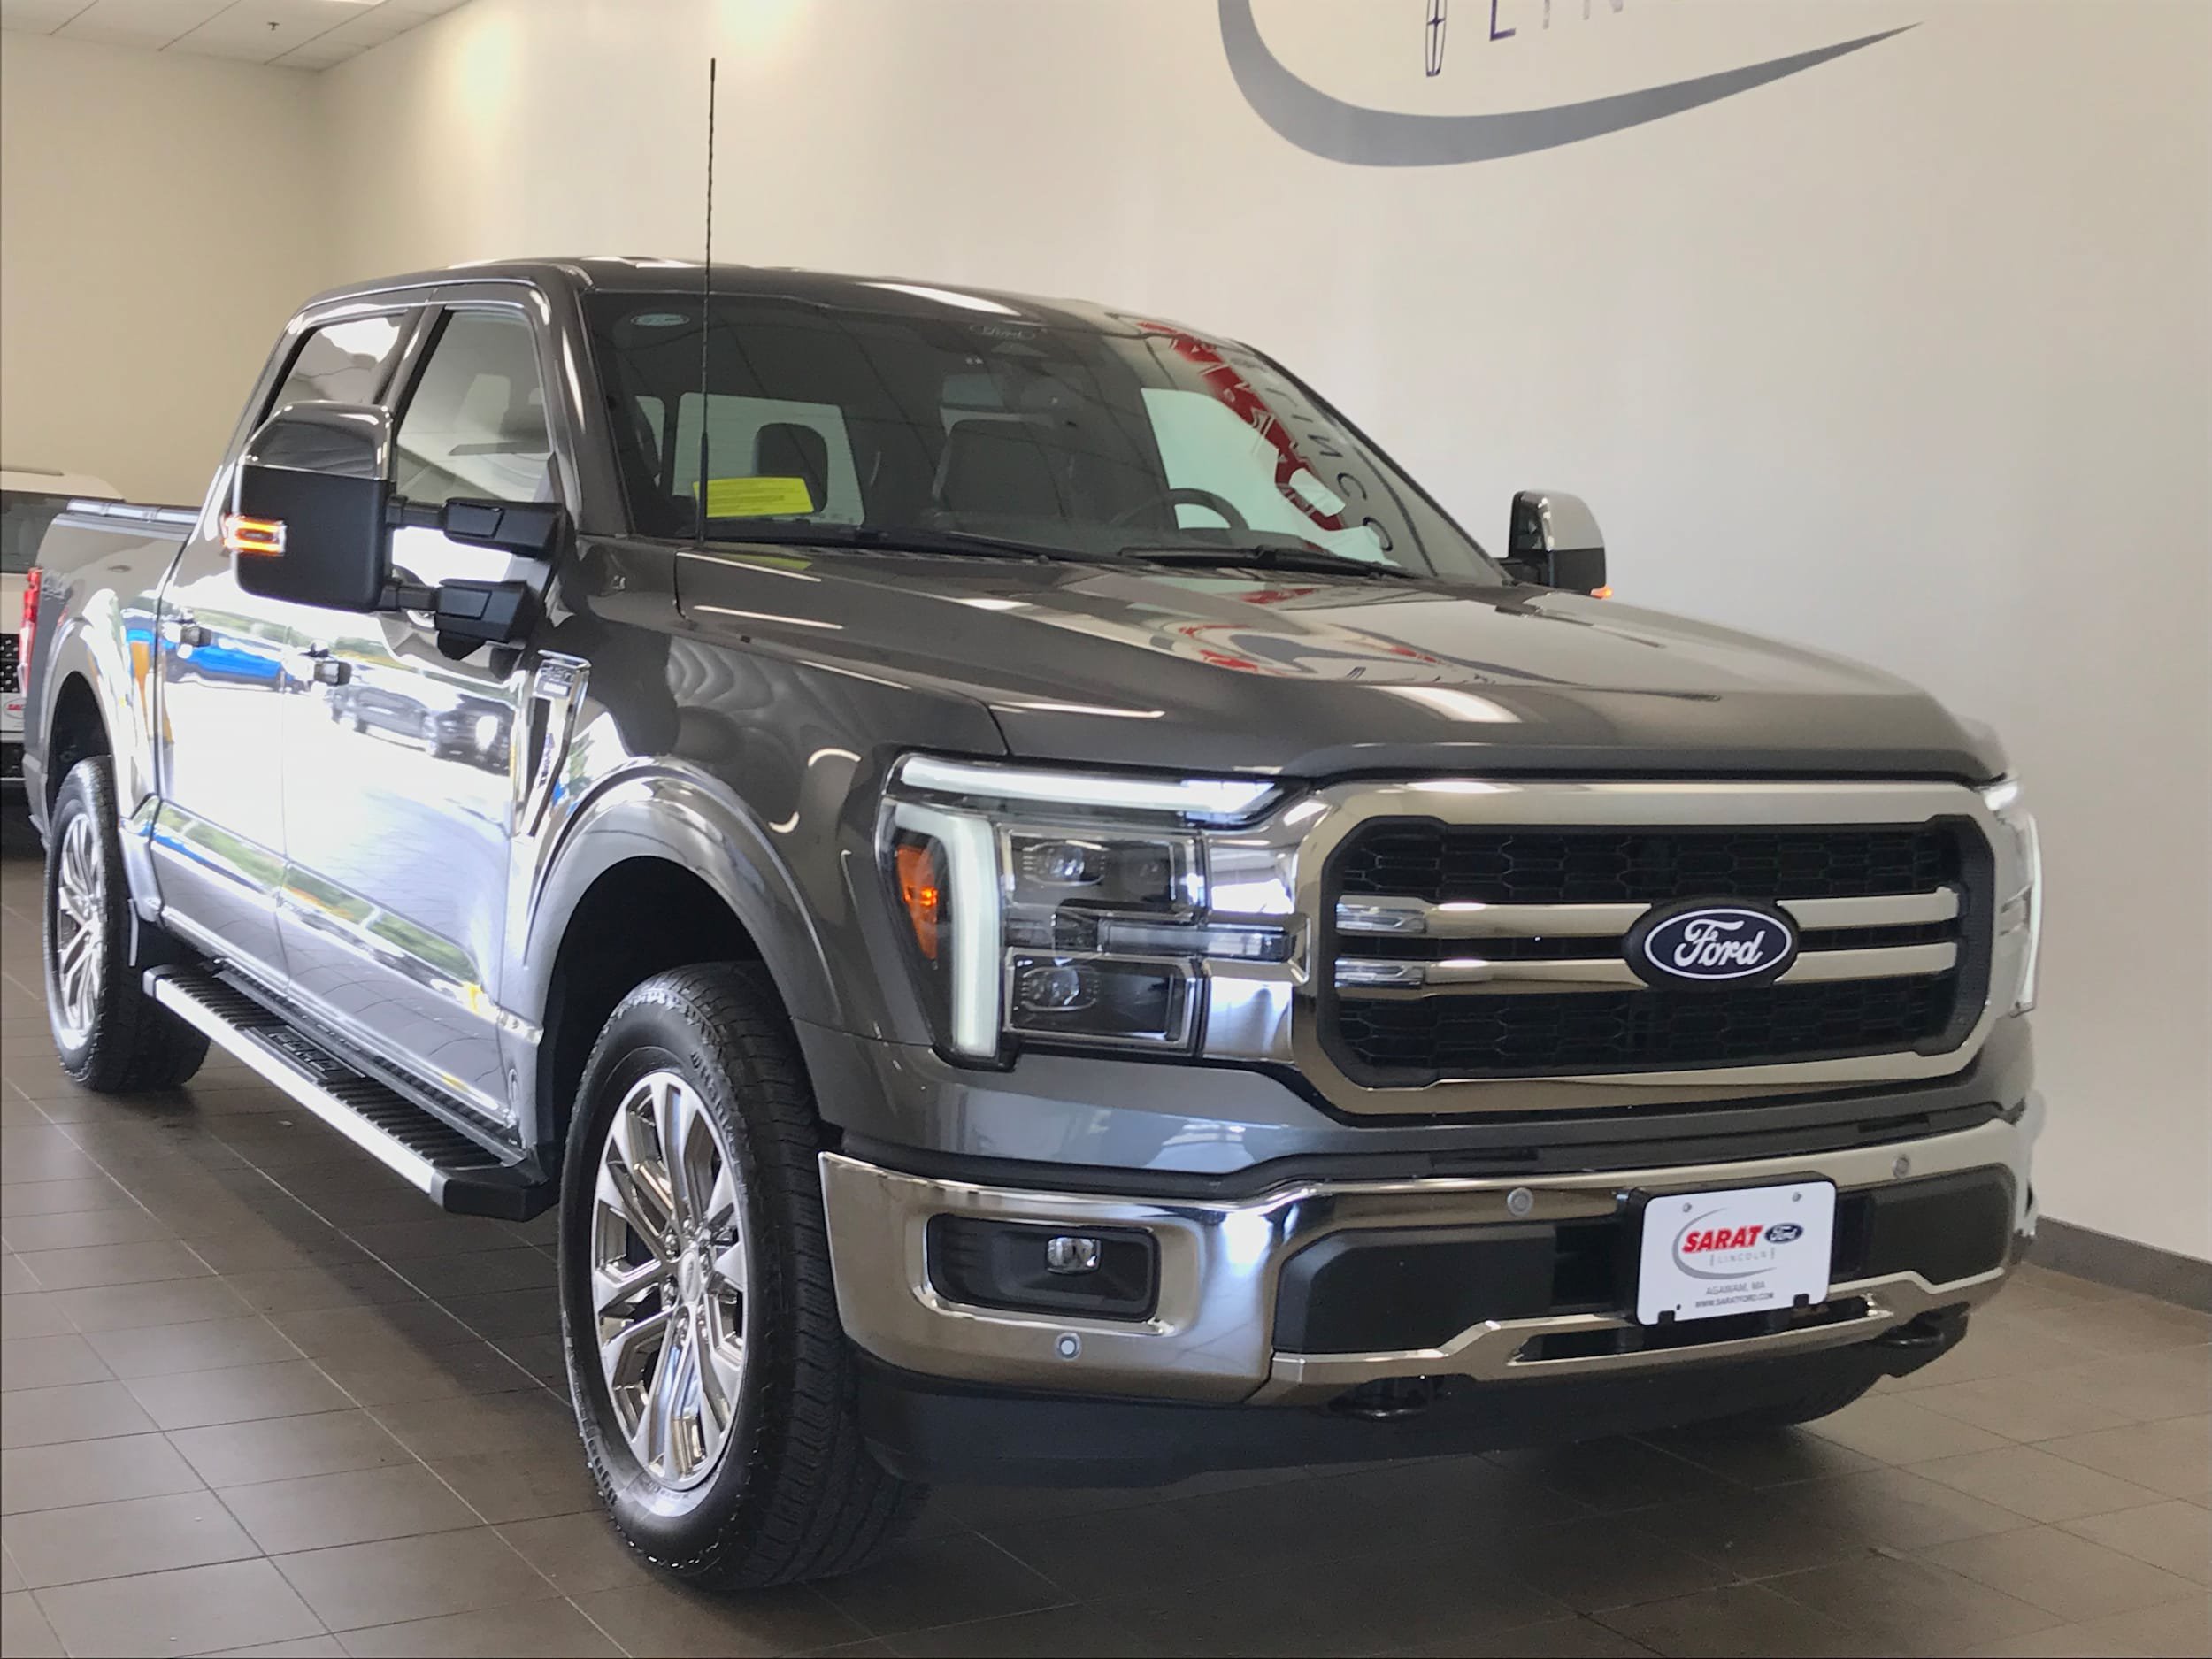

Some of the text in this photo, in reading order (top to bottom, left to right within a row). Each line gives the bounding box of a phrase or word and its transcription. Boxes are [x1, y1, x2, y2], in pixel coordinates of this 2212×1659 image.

[1674, 918, 1765, 967] Ford
[1682, 1225, 1763, 1254] SARAT
[1717, 1250, 1767, 1264] LINCOLN
